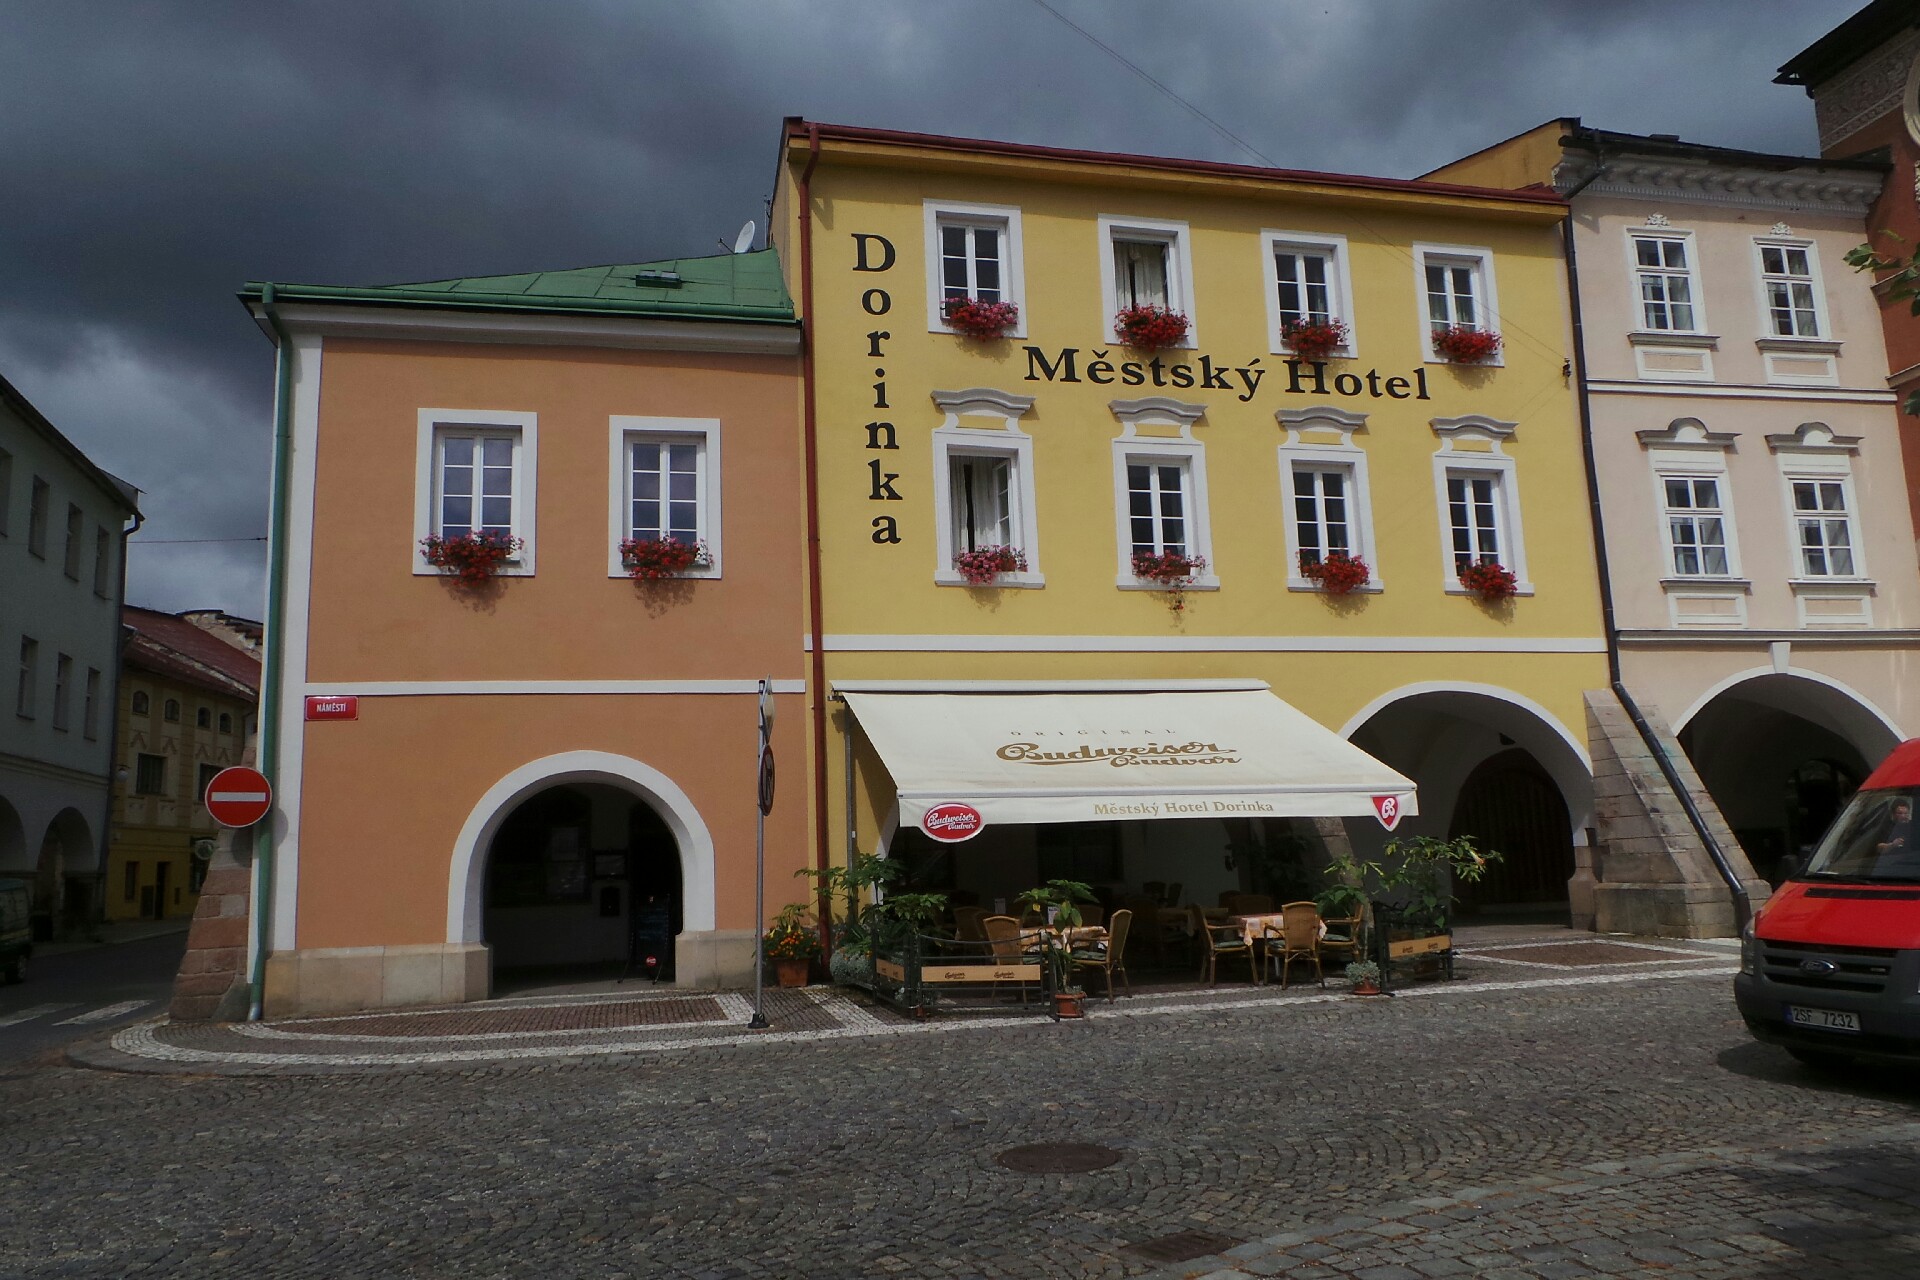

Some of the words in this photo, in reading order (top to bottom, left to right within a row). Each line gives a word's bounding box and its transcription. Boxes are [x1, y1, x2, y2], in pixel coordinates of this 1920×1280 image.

[1022, 346, 1266, 402] Městský
[1283, 359, 1431, 400] Hotel
[851, 233, 902, 544] Dorinka
[316, 702, 347, 712] NÁMĚSTÍ
[996, 742, 1237, 764] Budweiser
[1110, 755, 1242, 768] Budvar
[1094, 801, 1160, 816] Městský
[1165, 801, 1209, 813] Hotel
[1214, 800, 1275, 812] Dorinka
[927, 812, 977, 829] Budweiser
[1793, 1008, 1812, 1022] 2SF
[1822, 1011, 1854, 1028] 7232
